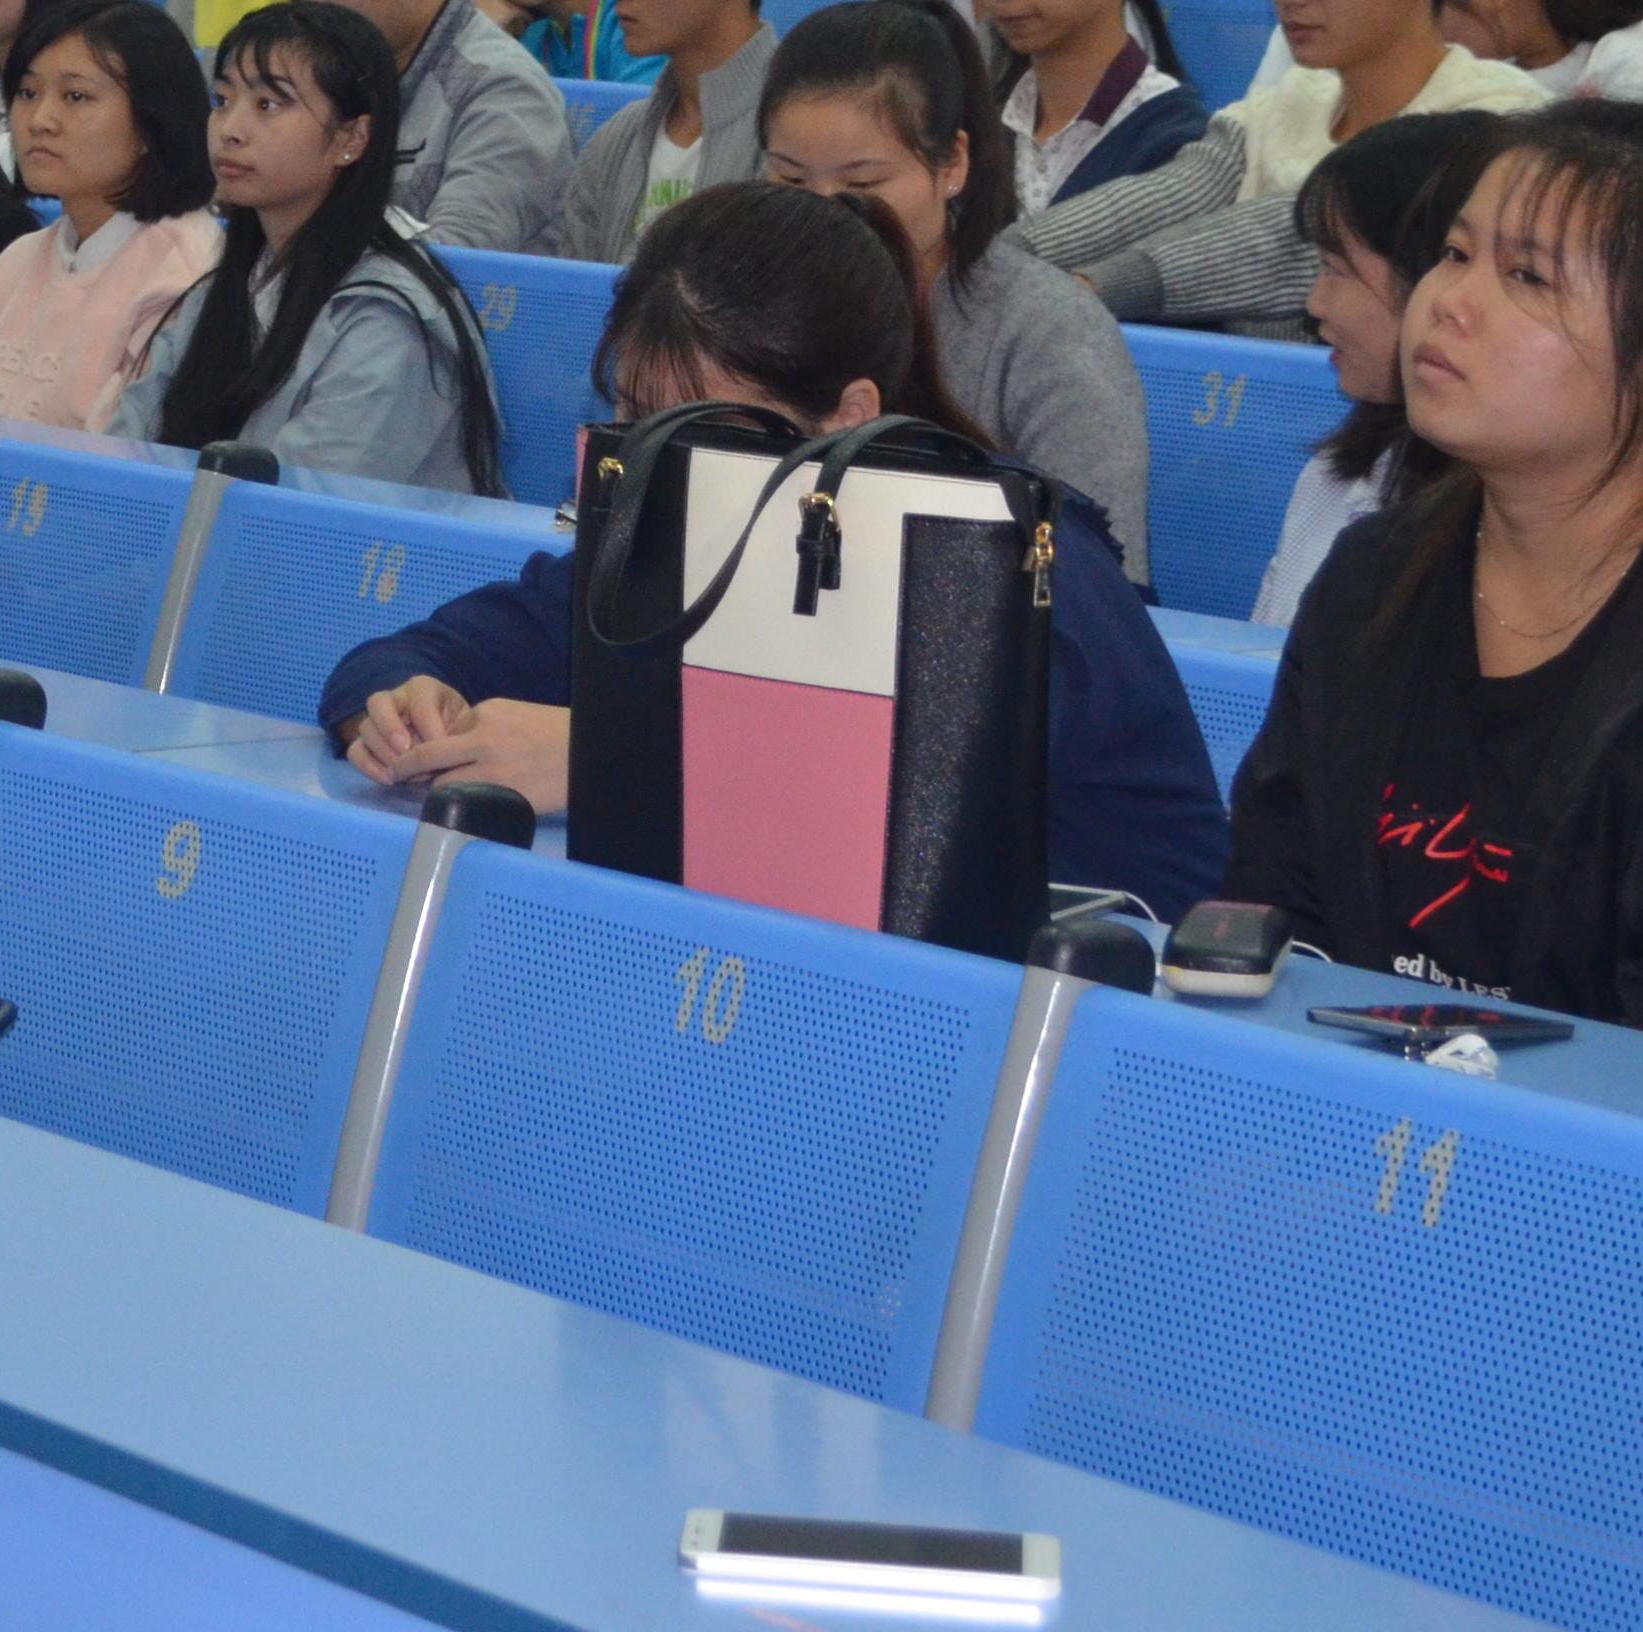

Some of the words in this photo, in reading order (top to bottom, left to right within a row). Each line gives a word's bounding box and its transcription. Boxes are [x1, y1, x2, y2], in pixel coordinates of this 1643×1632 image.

[1194, 370, 1250, 429] 31
[7, 475, 49, 536] 19
[358, 540, 408, 603] 18
[156, 821, 202, 899] 9
[677, 947, 746, 1044] 10
[1392, 953, 1425, 979] ed
[1429, 959, 1454, 990] by
[1374, 1115, 1459, 1228] 11
